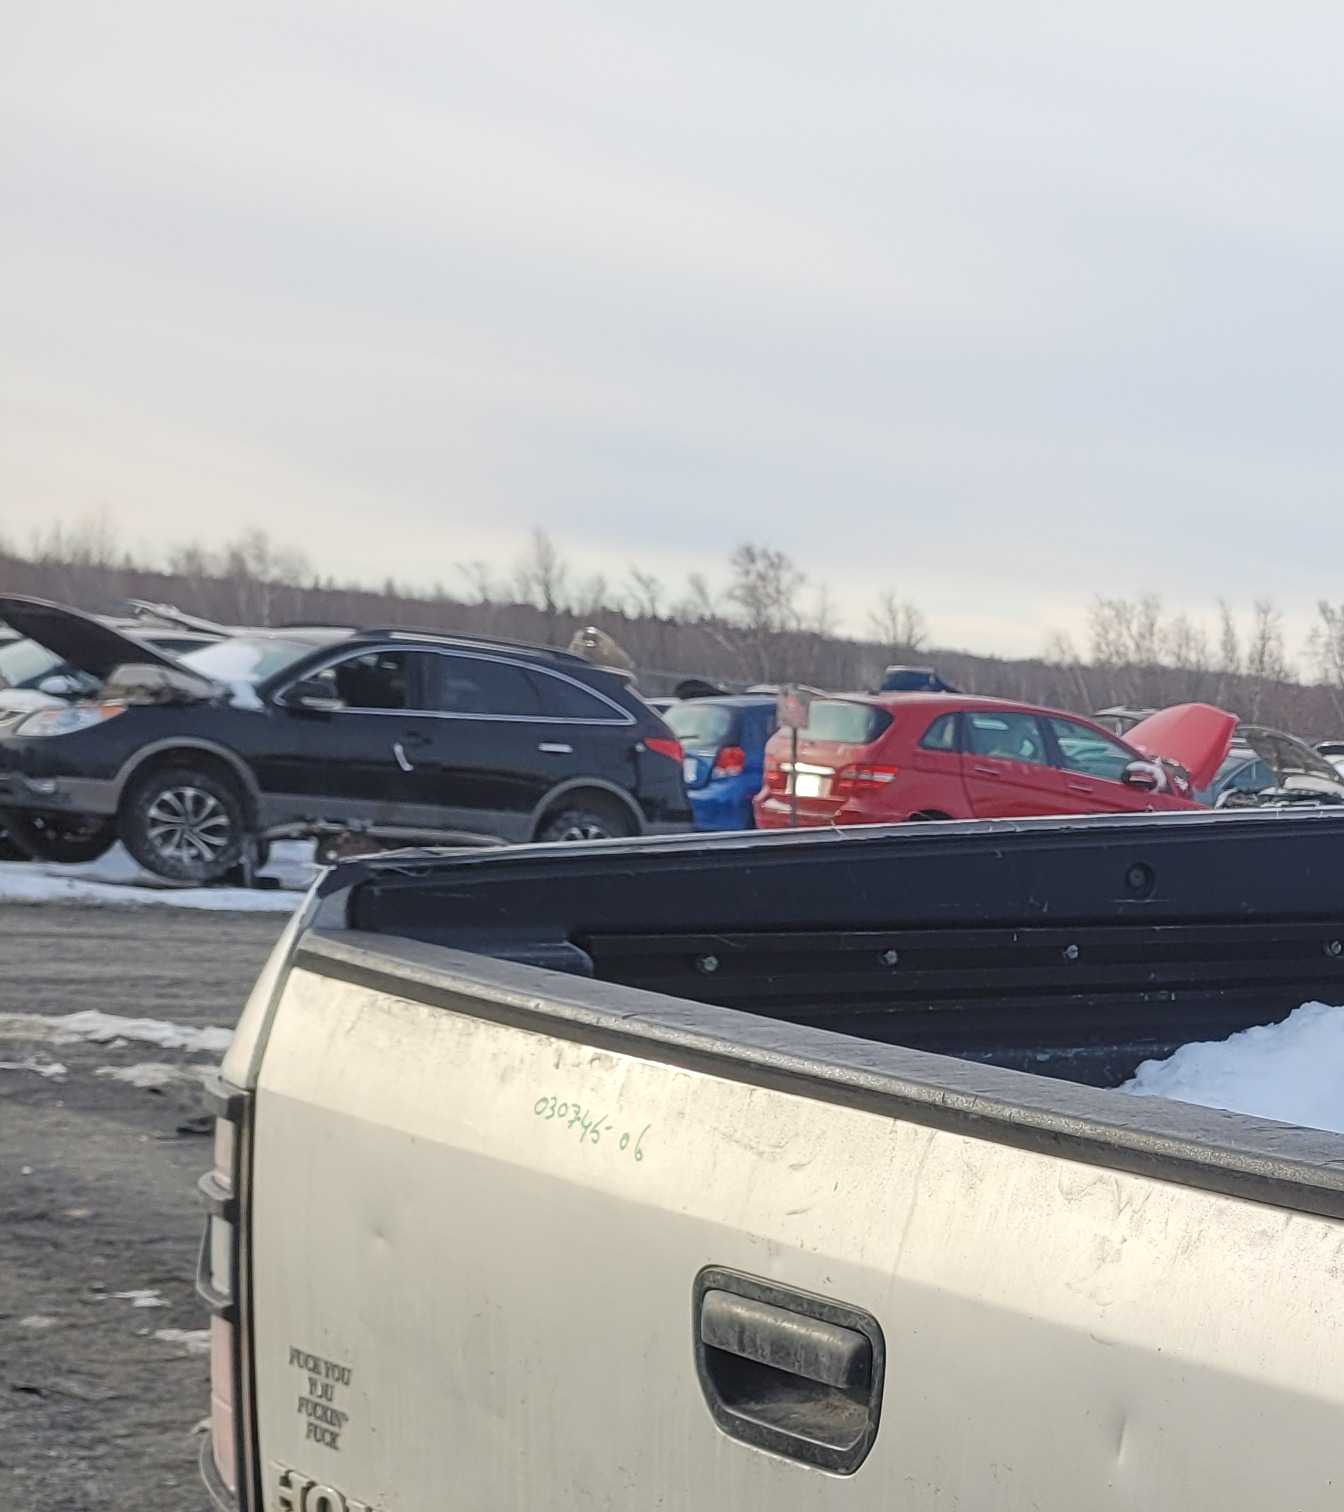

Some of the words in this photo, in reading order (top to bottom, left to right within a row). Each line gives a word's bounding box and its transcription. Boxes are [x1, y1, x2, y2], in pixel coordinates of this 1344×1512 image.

[288, 1345, 322, 1376] FUCK
[323, 1360, 352, 1386] YOU
[306, 1420, 340, 1451] FUCK
